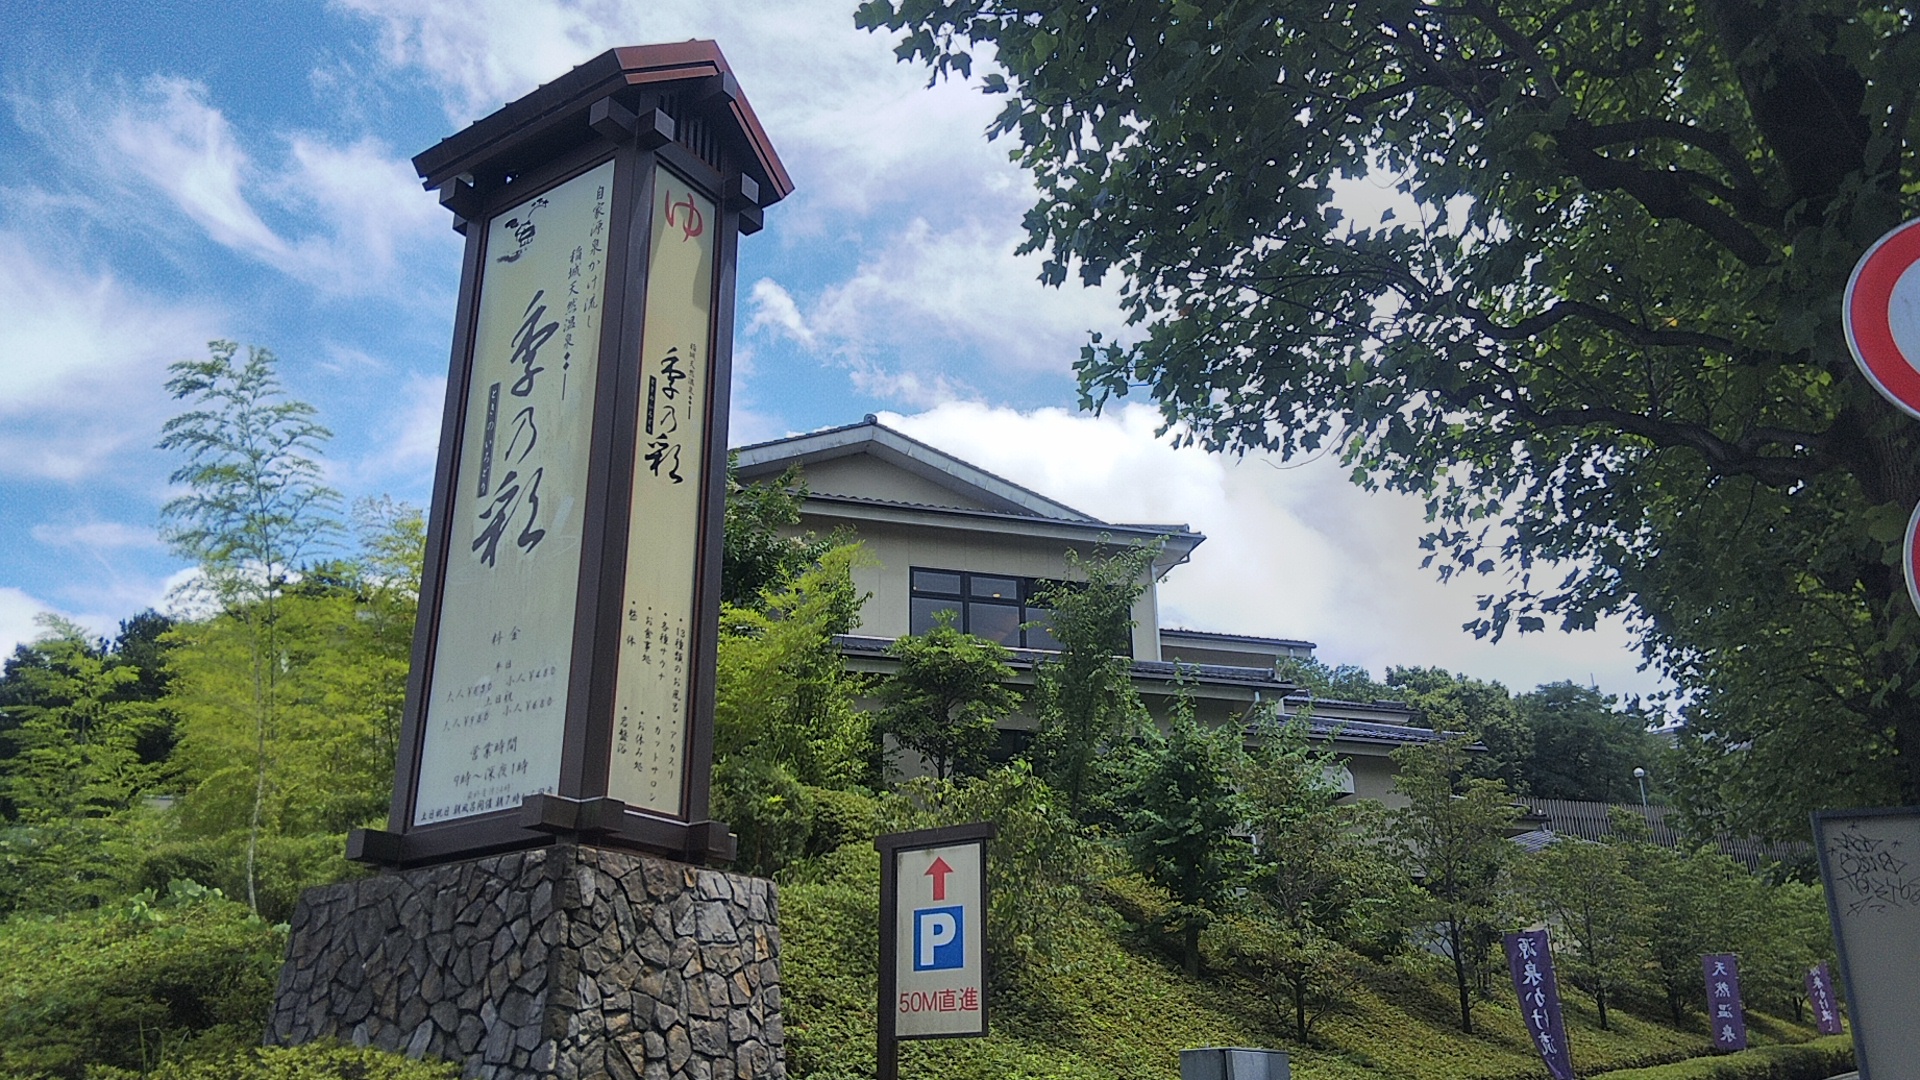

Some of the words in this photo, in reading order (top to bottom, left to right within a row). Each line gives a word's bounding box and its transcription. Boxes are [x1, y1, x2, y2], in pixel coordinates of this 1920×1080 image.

[664, 189, 704, 243] ゆ
[584, 185, 606, 328] 自家源泉かけ流し
[563, 245, 583, 349] 稲城天然温泉
[472, 289, 560, 569] 季乃彩
[644, 346, 687, 485] 季乃彩
[470, 736, 518, 761] 営業時間
[919, 912, 957, 966] P
[899, 986, 979, 1013] 50M直進
